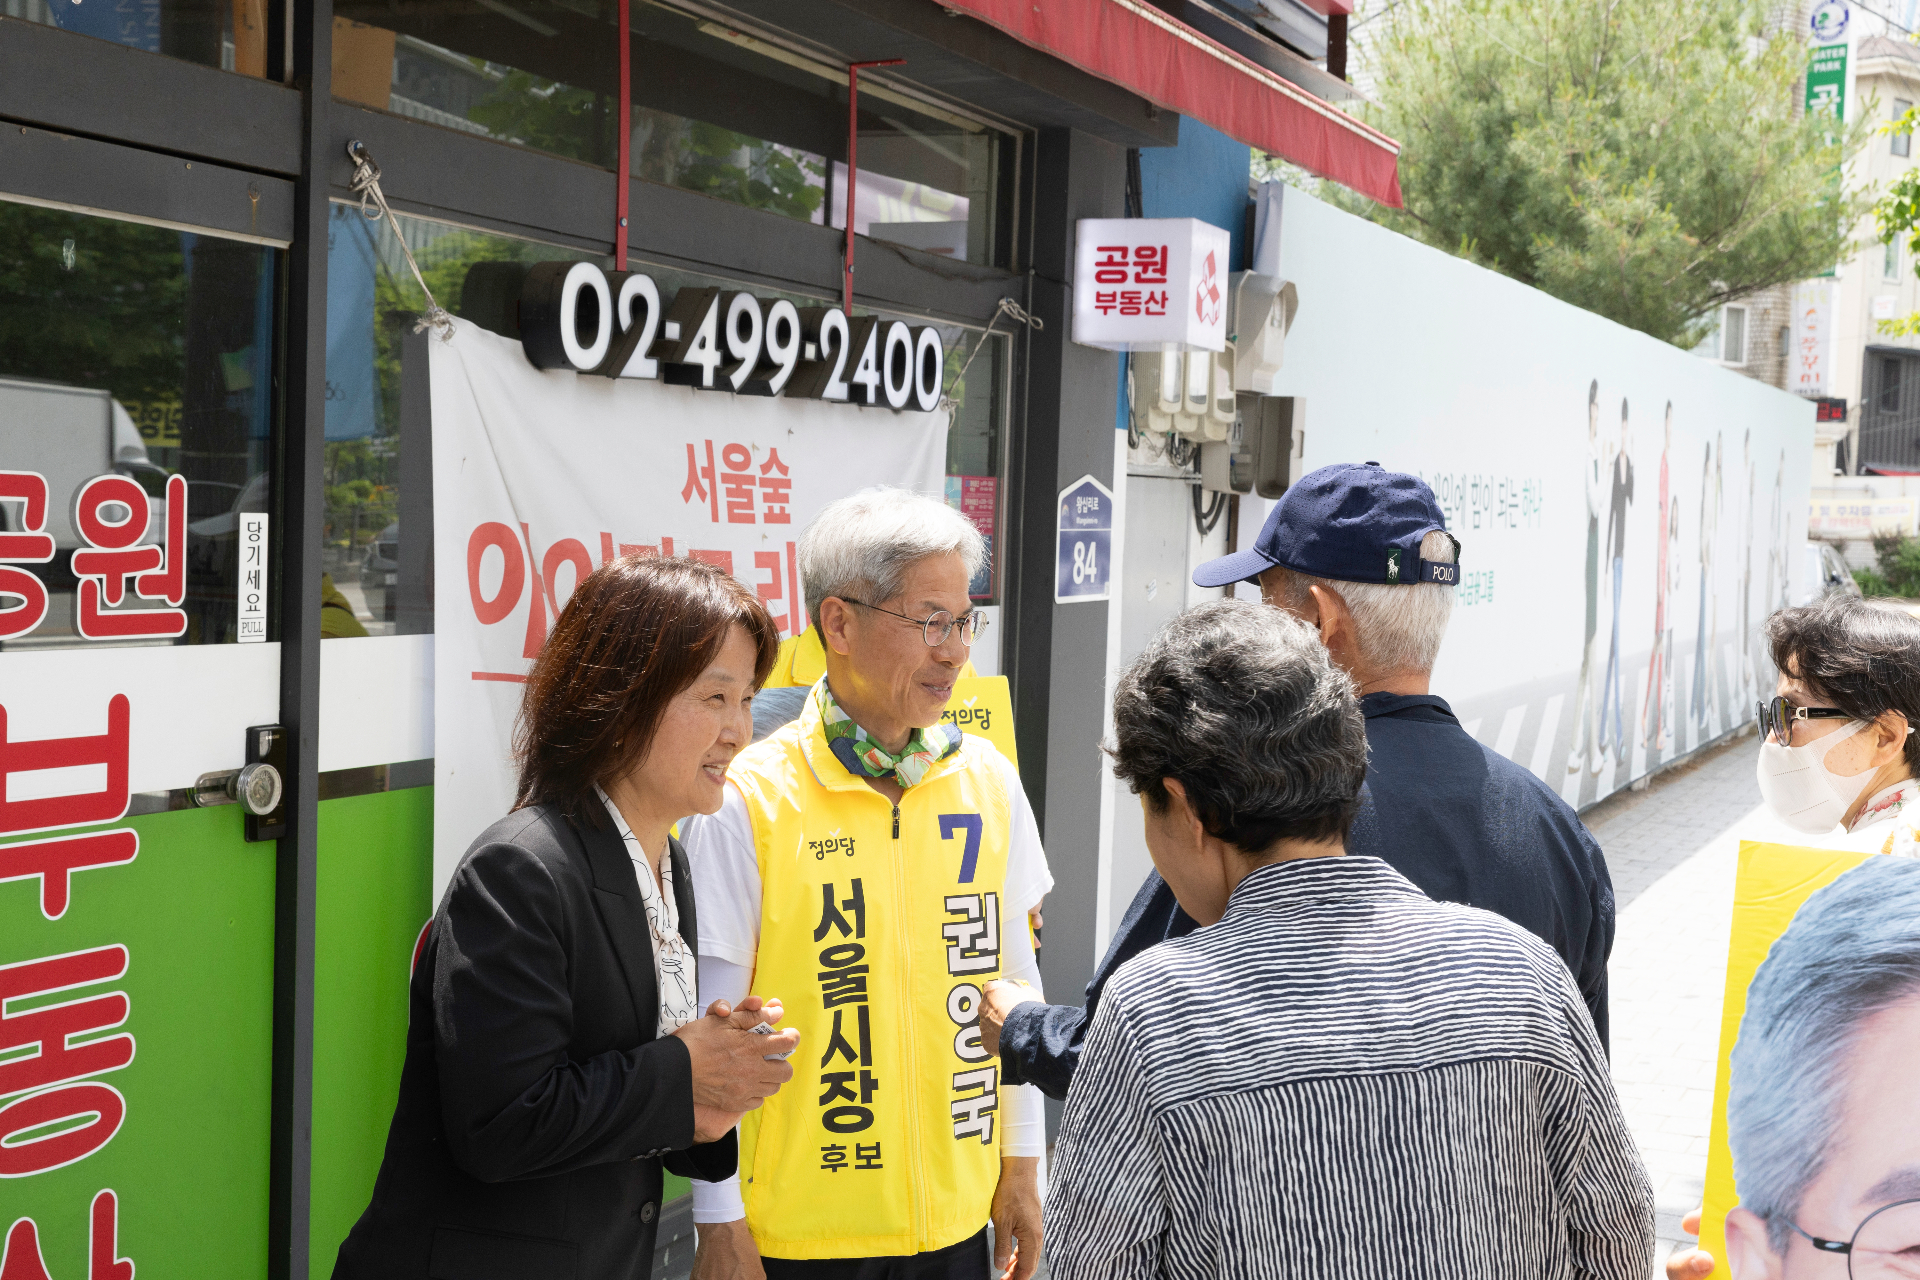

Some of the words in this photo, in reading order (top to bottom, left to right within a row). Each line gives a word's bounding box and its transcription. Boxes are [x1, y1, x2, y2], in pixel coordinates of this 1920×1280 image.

[1094, 244, 1168, 285] 공원
[1094, 290, 1169, 316] 부동산
[560, 261, 944, 412] 02-499-2400
[680, 438, 793, 526] 서울숲
[1471, 473, 1494, 530] 힘이
[1076, 495, 1099, 513] 왕십리로
[245, 521, 262, 612] 당기세요
[1072, 541, 1098, 585] 84
[1432, 565, 1454, 582] POLO
[241, 621, 264, 634] PULL
[808, 836, 856, 861] 정의당
[938, 814, 983, 884] 7
[813, 877, 880, 1134] 서울시장
[820, 1141, 884, 1174] 후보
